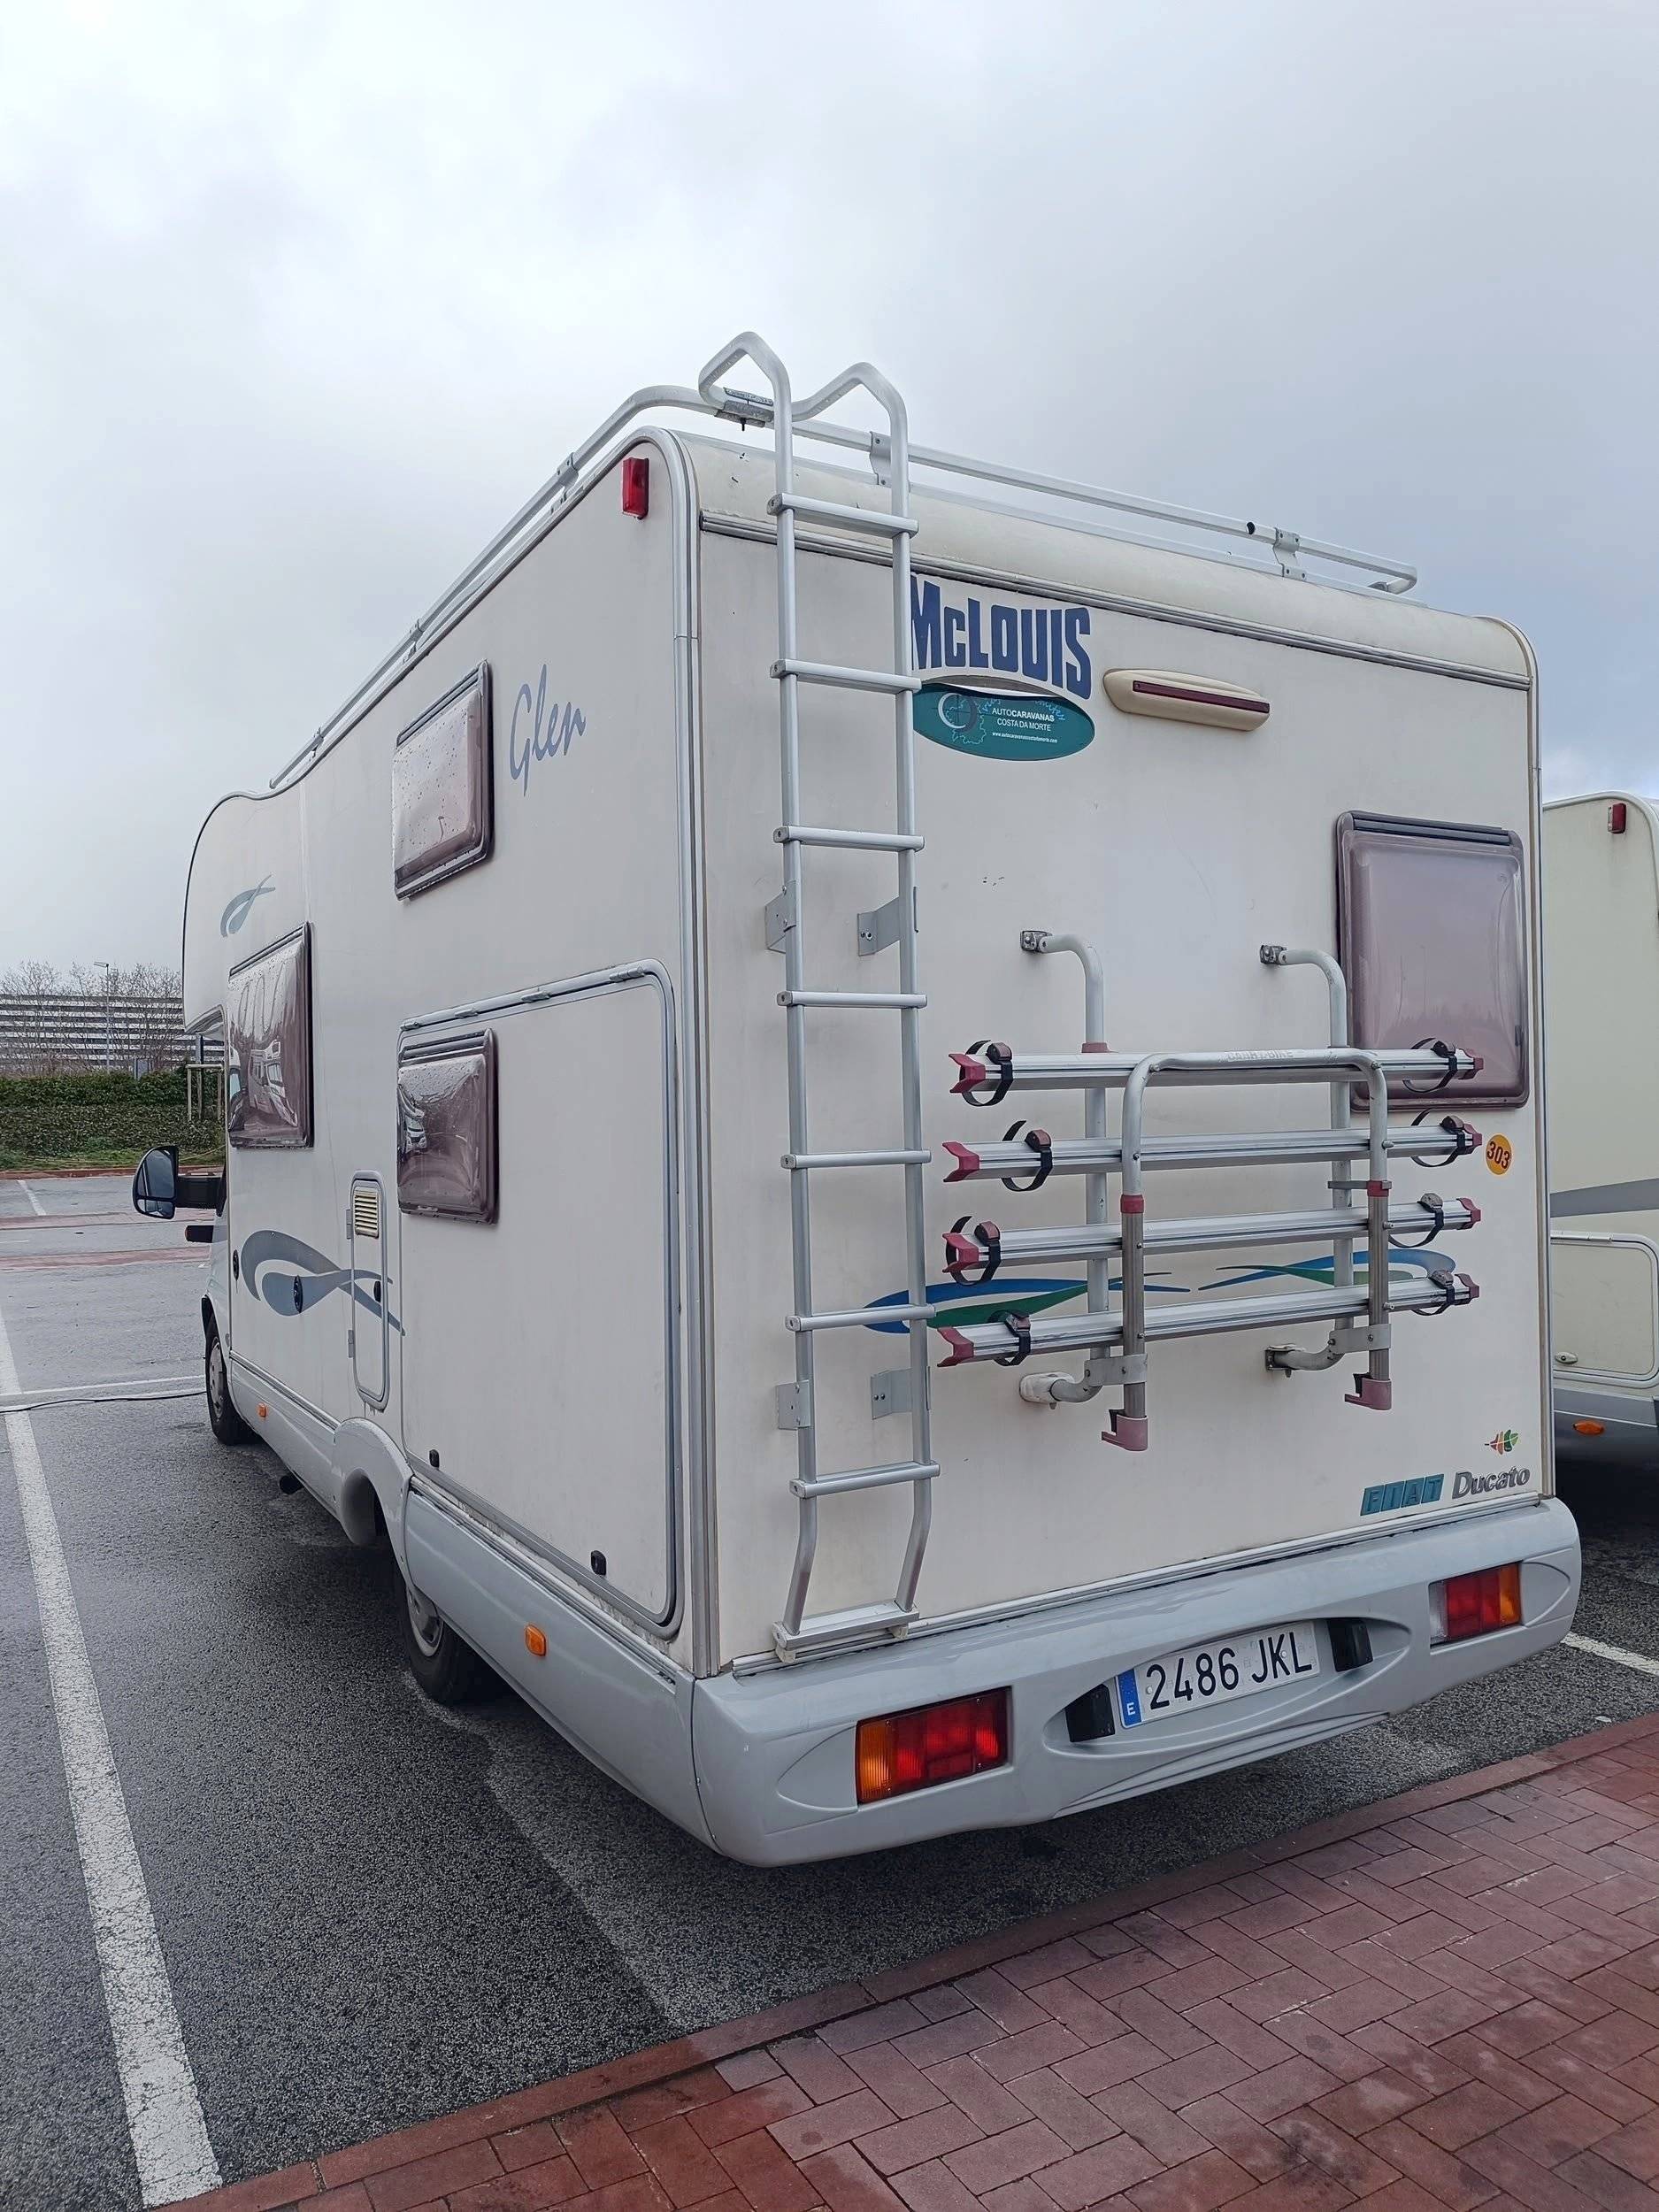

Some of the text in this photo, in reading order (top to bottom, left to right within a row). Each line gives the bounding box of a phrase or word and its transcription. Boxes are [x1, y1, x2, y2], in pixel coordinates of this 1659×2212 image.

[510, 664, 586, 797] Glen
[992, 708, 1056, 722] AUTOCARAVANAS
[997, 718, 1018, 727] COSTA
[1029, 722, 1052, 732] MORTE
[1486, 1141, 1510, 1169] 303
[1361, 1466, 1531, 1516] FIAT Ducato
[1126, 1632, 1312, 1716] E 2486 JKL
